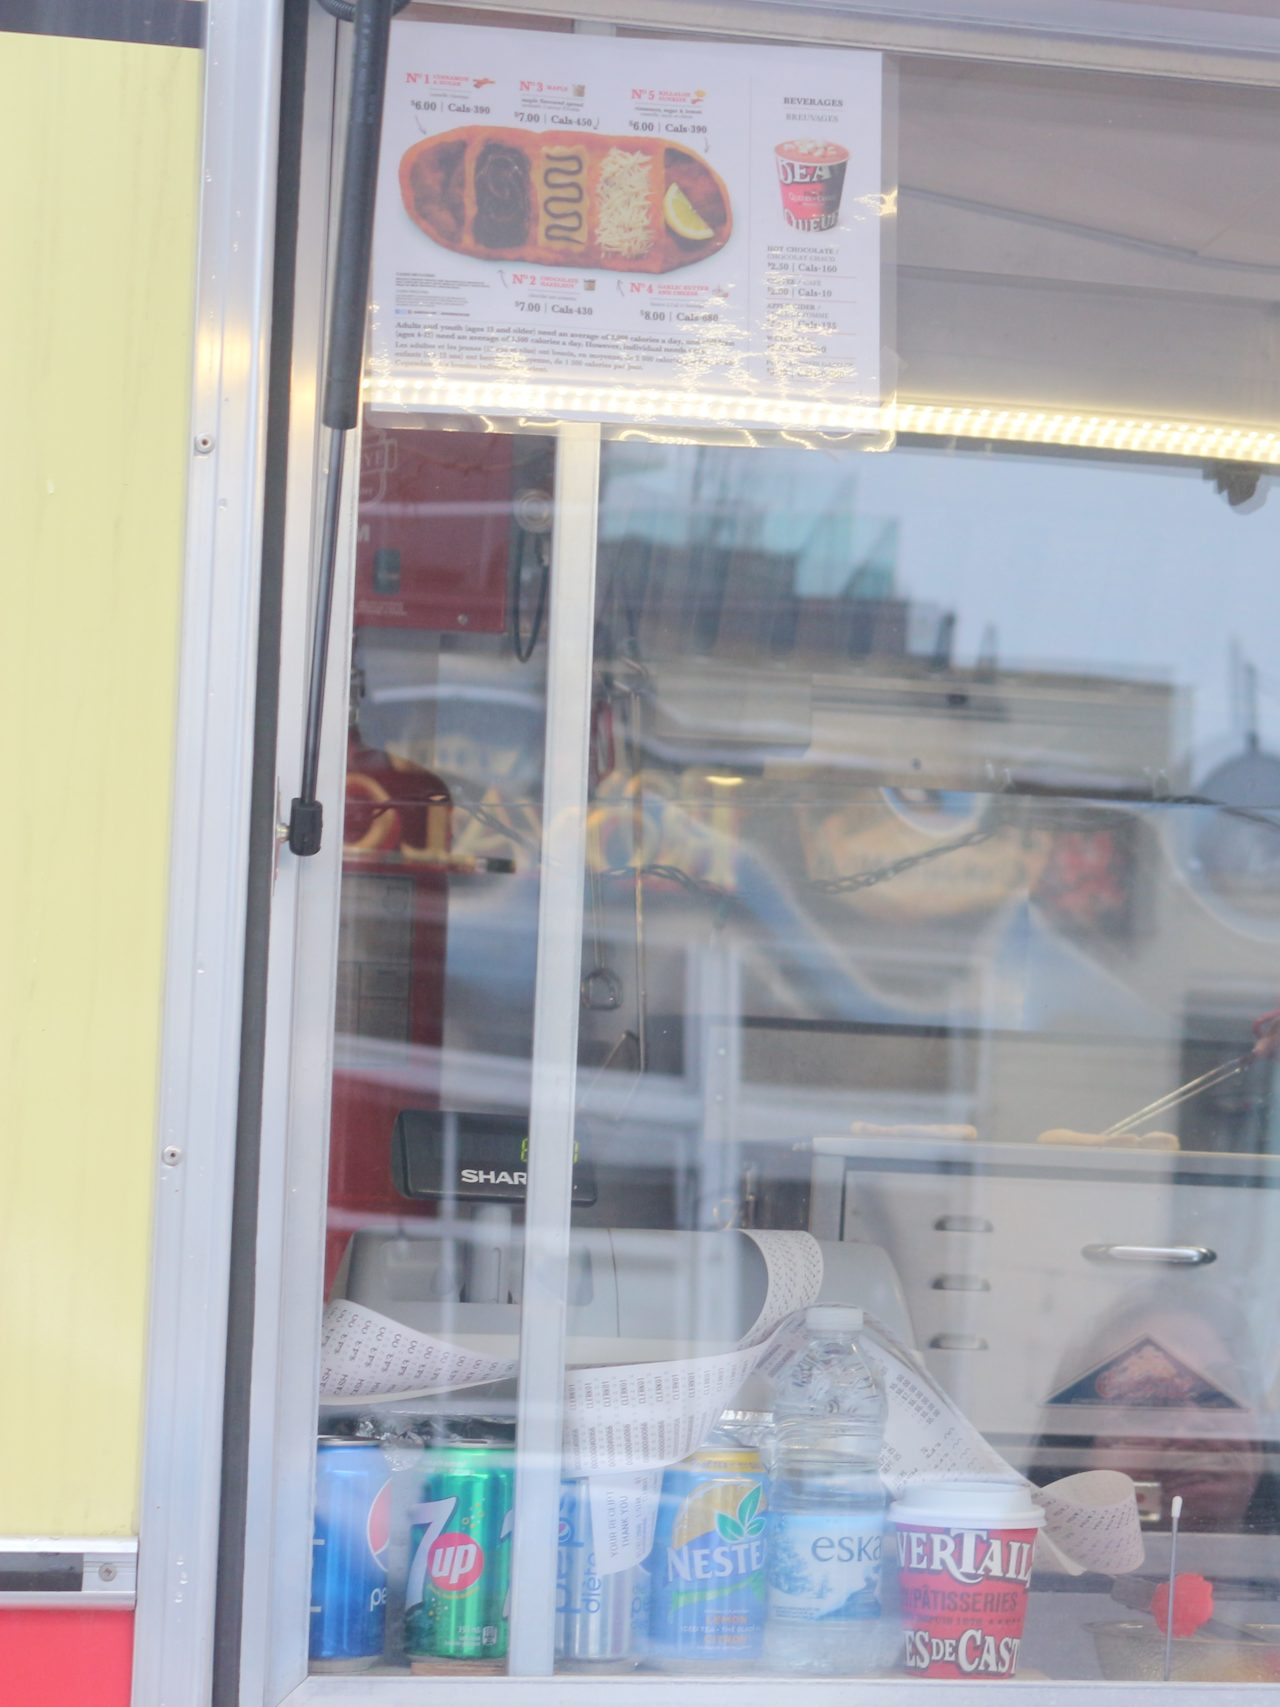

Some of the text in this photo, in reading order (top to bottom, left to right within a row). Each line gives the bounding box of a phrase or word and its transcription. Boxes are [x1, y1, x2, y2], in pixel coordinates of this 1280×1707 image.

[783, 97, 843, 107] BEVERAGES
[785, 113, 839, 122] BREUVAGES
[798, 263, 838, 273] Cals-160
[798, 288, 832, 298] Cals-10
[620, 1496, 630, 1547] THANK YOU
[913, 1584, 1018, 1614] PÂTISSERIES
